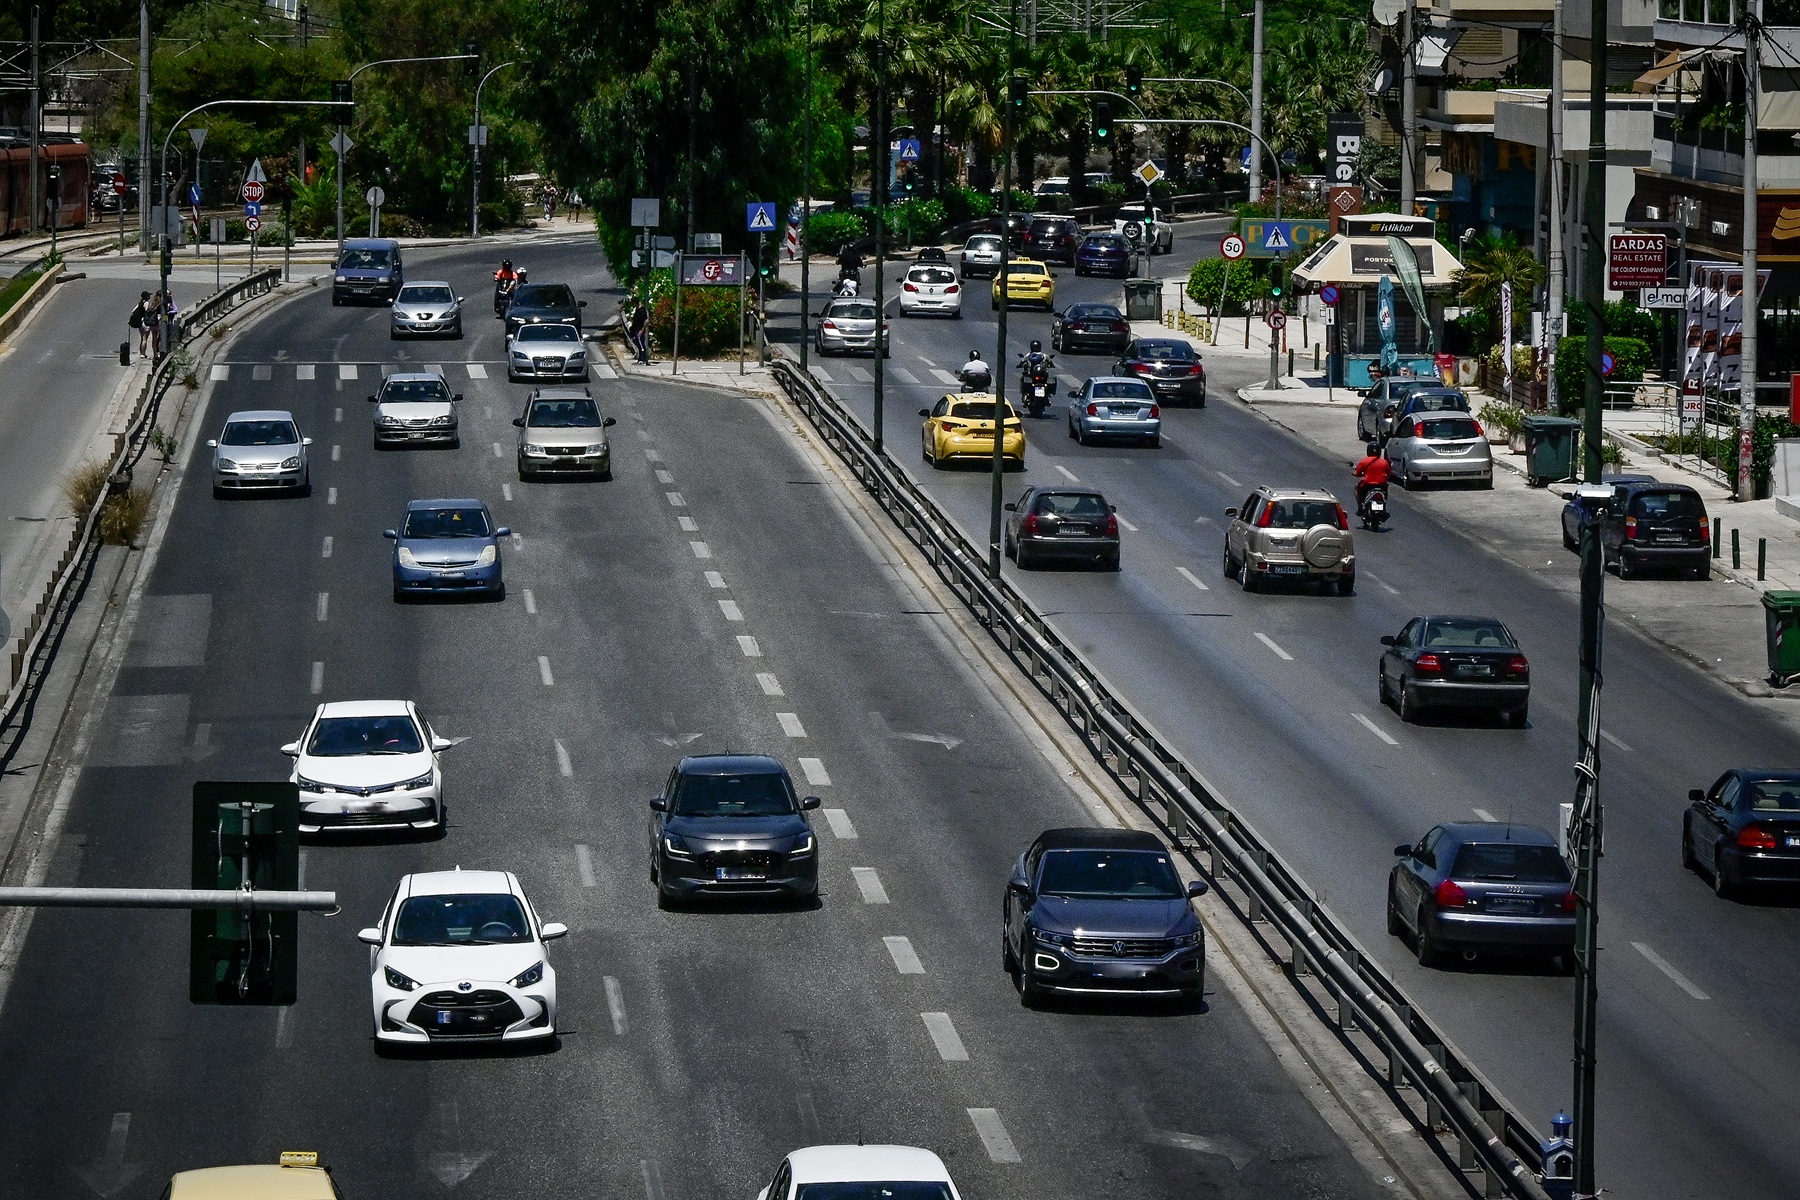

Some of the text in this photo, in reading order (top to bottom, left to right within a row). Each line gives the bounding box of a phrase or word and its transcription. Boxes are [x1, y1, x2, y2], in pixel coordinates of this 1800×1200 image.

[244, 186, 262, 197] STOP
[1381, 223, 1414, 232] istikbal
[1225, 243, 1240, 253] 50
[1612, 239, 1664, 250] LARDAS
[1613, 254, 1662, 262] REAL ESTATE
[1640, 266, 1664, 274] COMPANY
